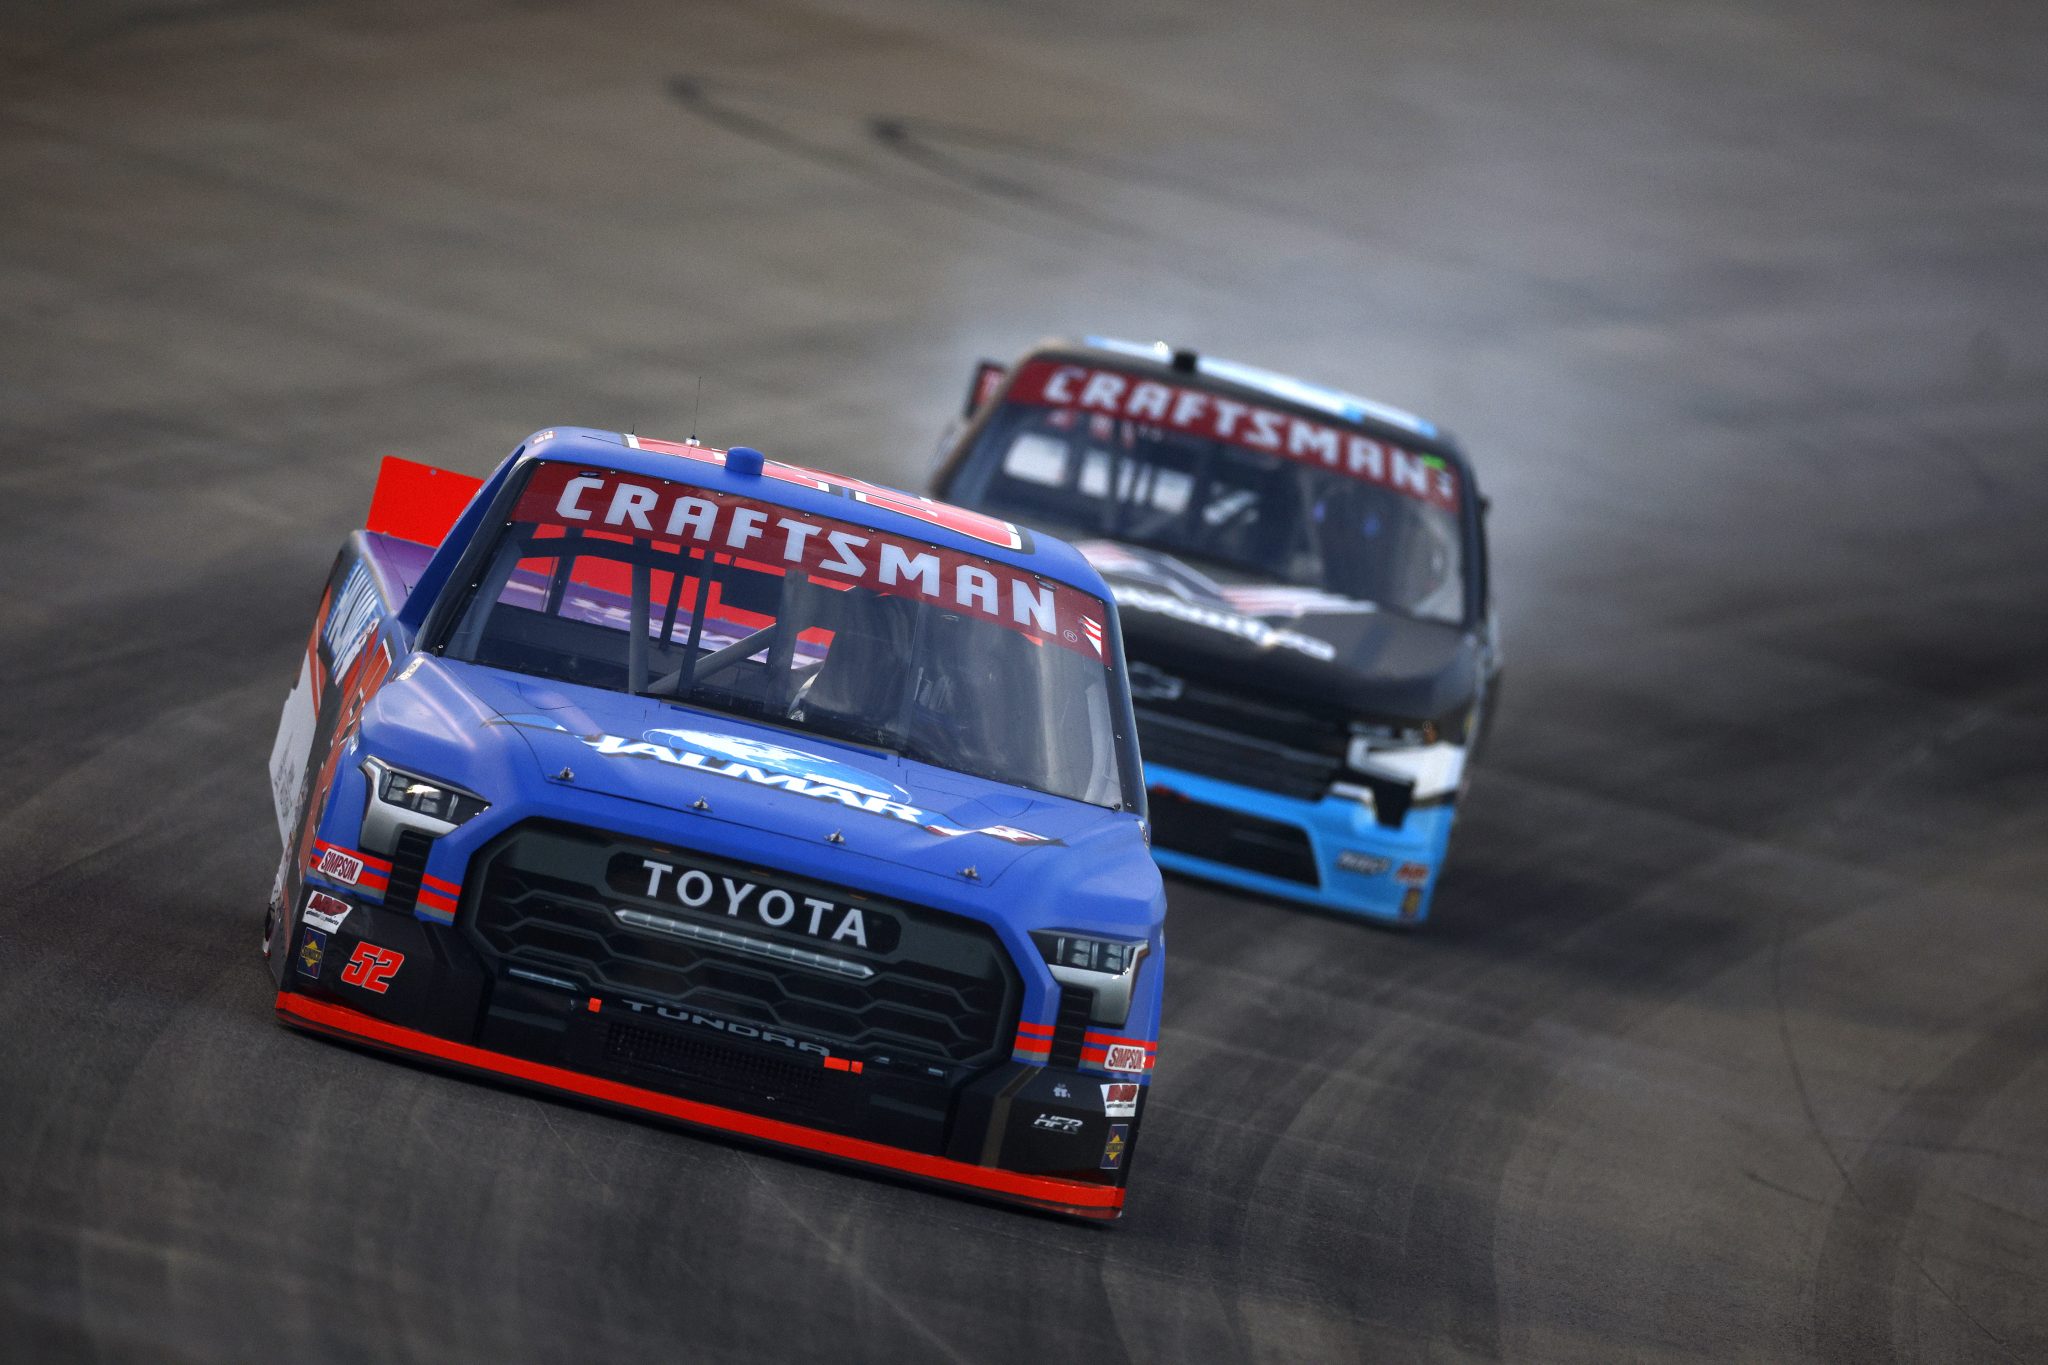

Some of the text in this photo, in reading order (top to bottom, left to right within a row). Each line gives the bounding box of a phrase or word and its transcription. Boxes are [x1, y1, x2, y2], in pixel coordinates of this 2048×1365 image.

[1042, 366, 1429, 496] CRAFTSMAN
[556, 476, 1057, 635] CRAFTSMAN
[321, 851, 359, 881] SIMPSON
[643, 859, 867, 949] TOYOTA
[341, 941, 405, 995] 52
[621, 999, 830, 1057] TUNDRA
